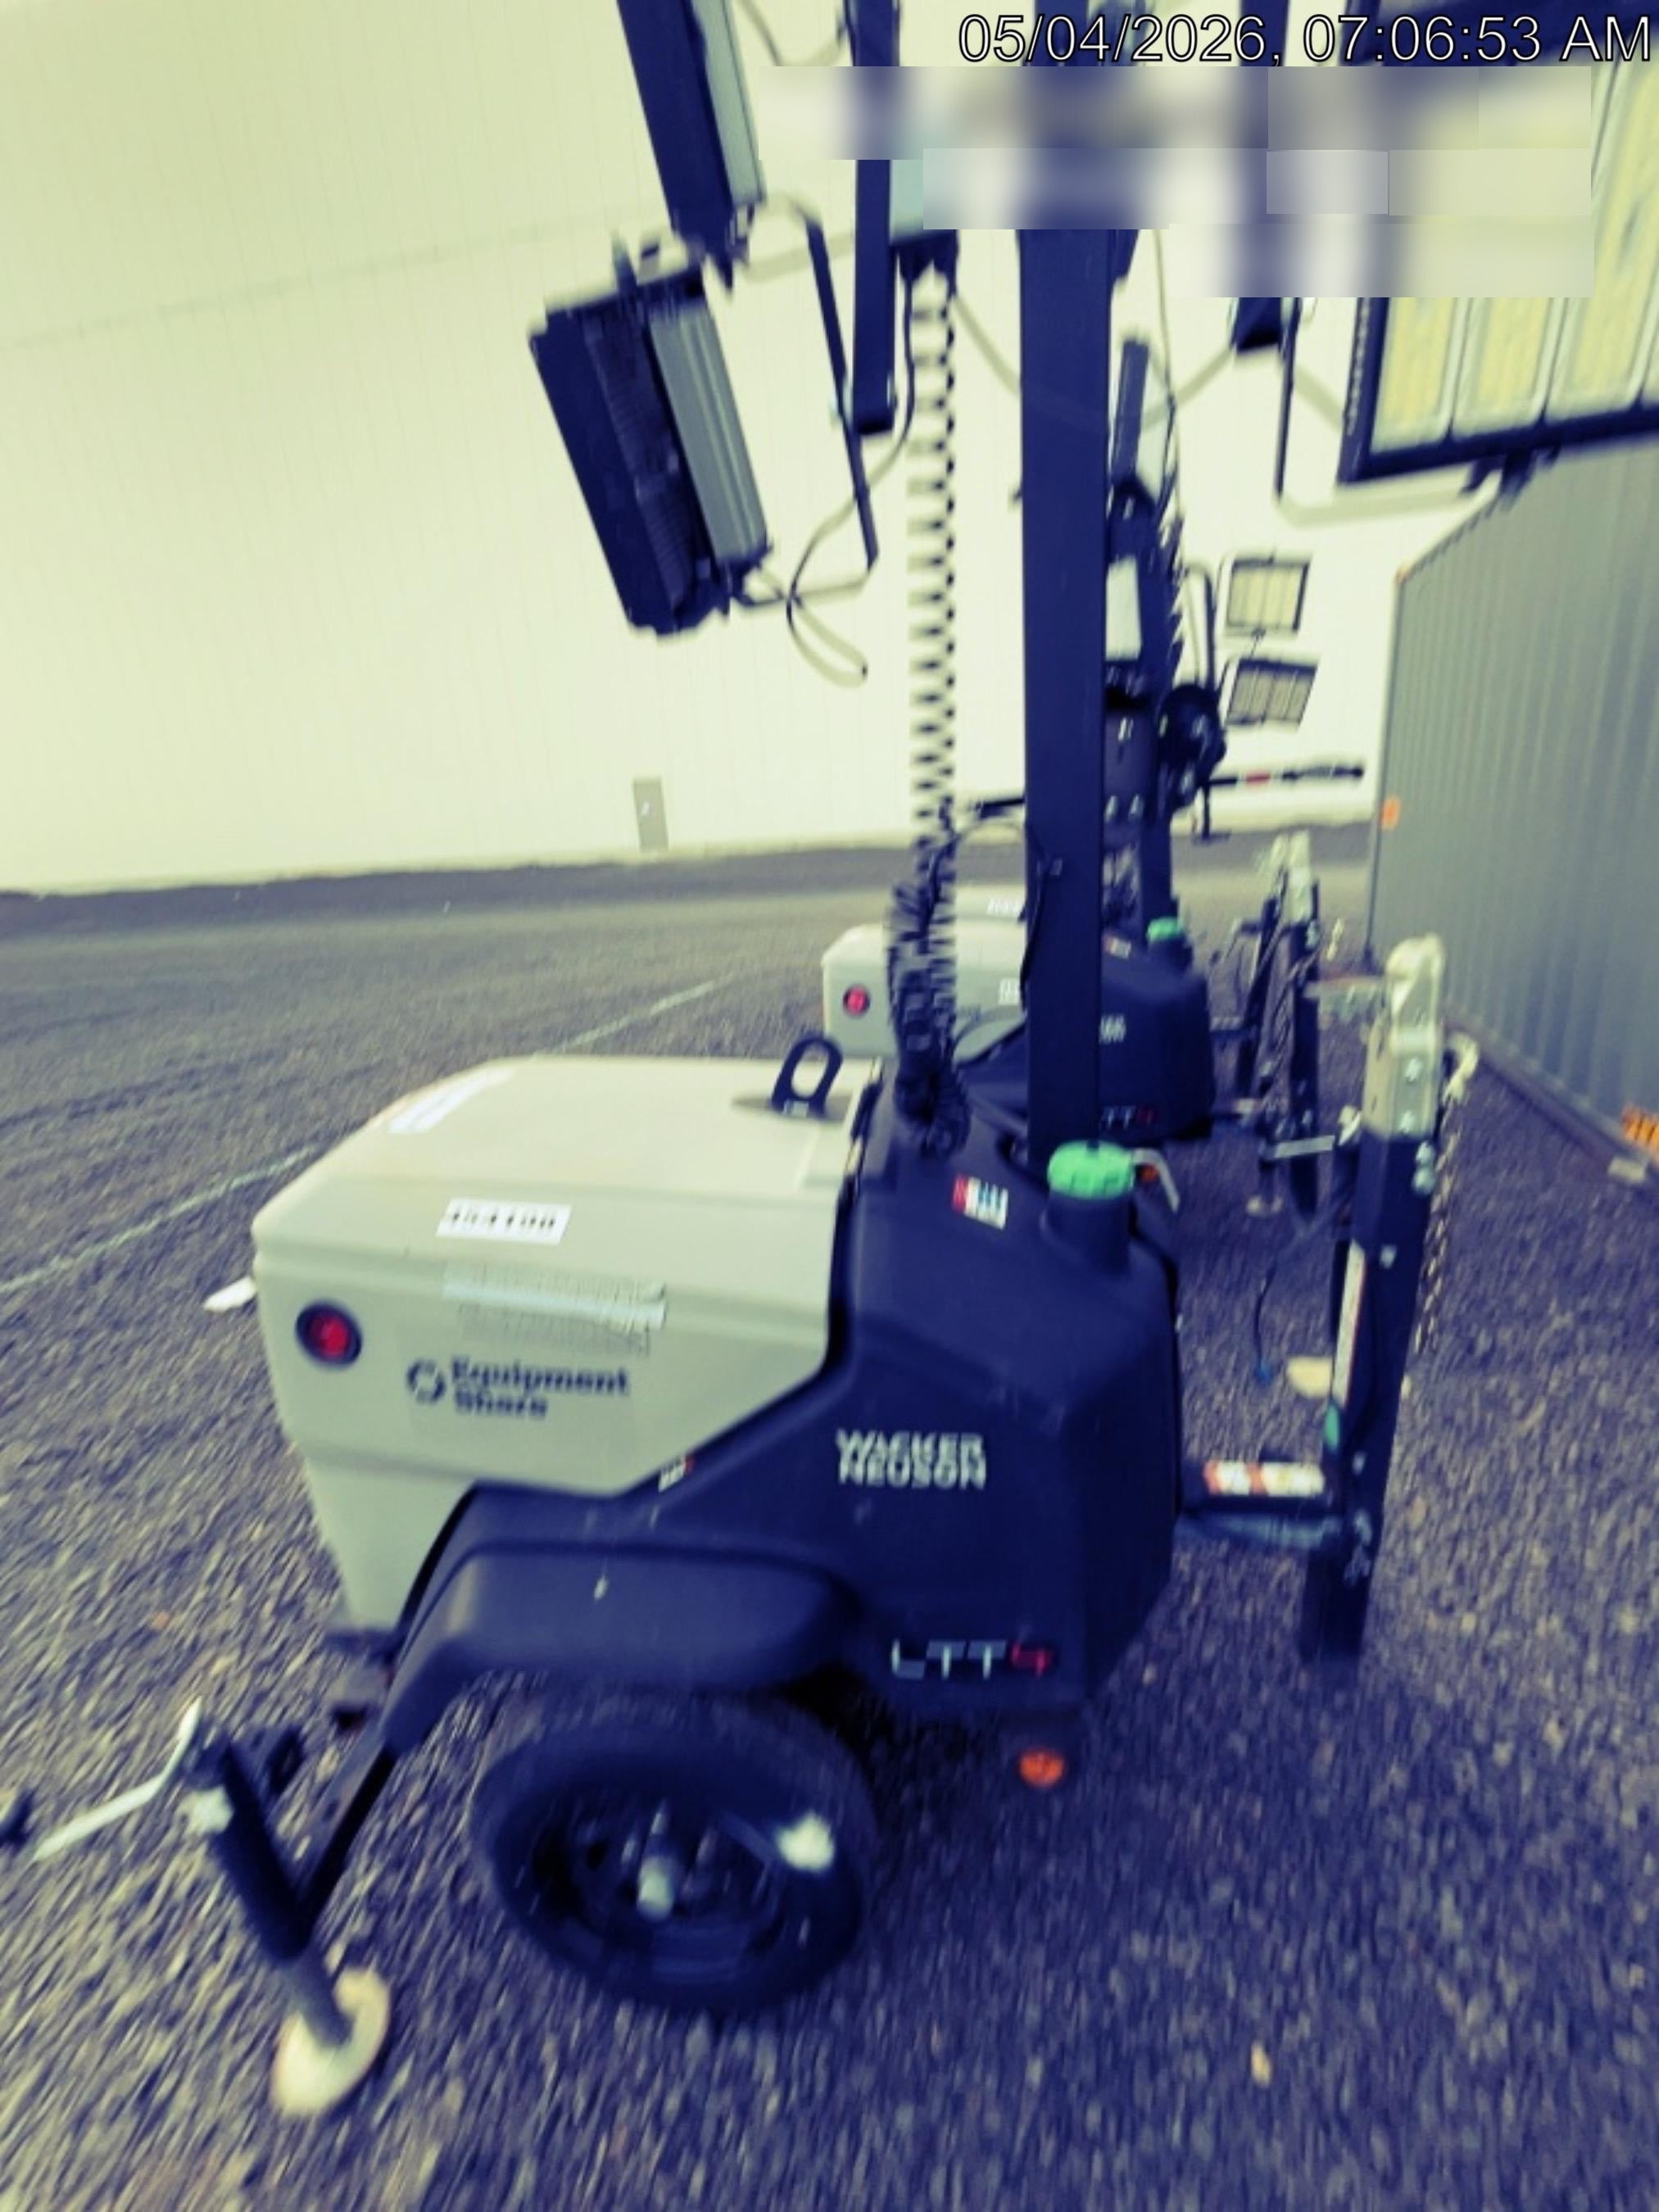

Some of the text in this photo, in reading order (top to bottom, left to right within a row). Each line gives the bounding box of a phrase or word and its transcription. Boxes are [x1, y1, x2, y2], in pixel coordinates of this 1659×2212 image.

[451, 1356, 629, 1394] Equipment
[454, 1388, 547, 1418] Share
[836, 1428, 984, 1460] WACKER
[839, 1454, 986, 1489] NEUSON
